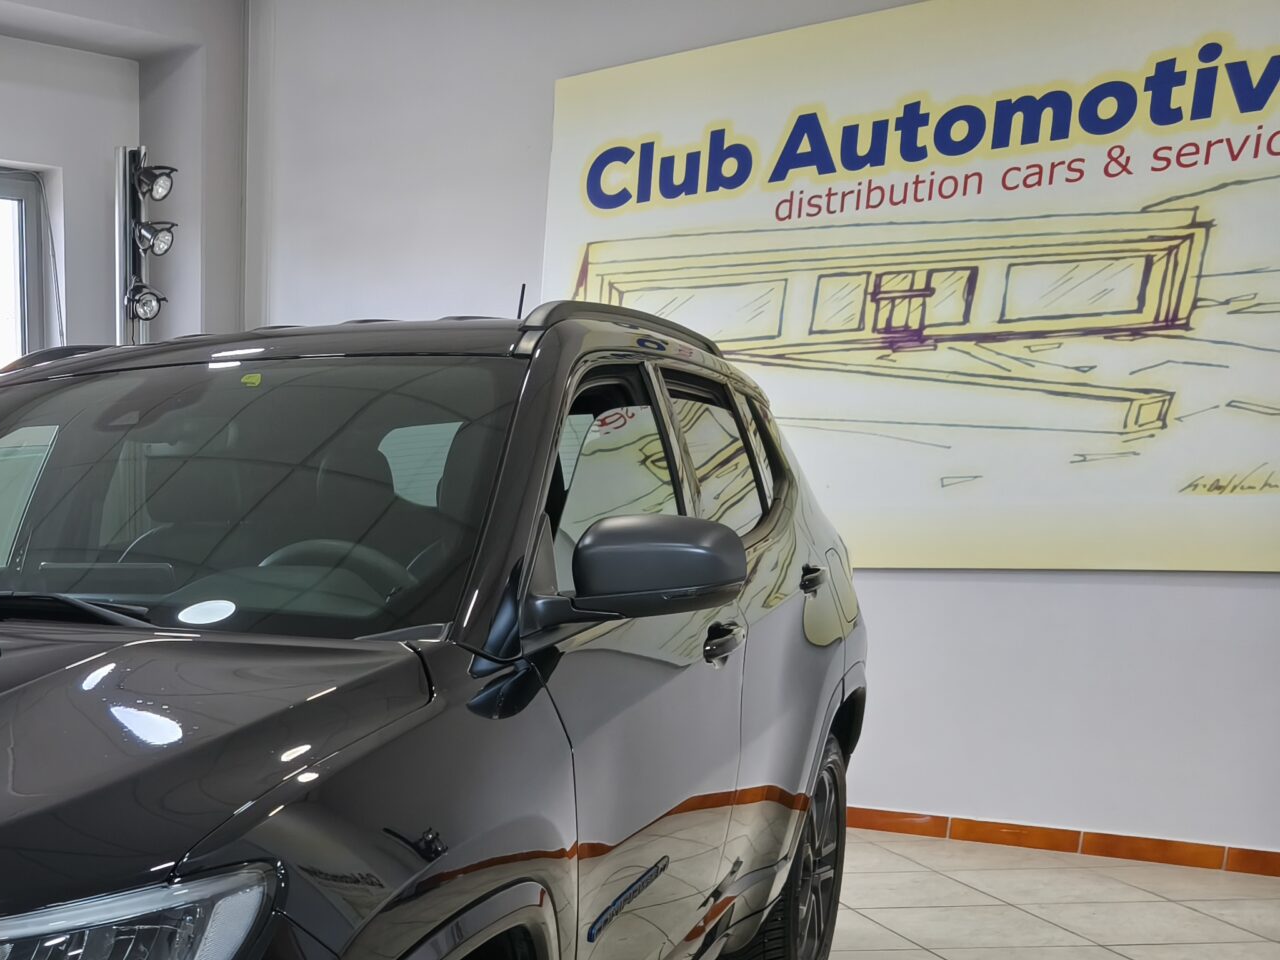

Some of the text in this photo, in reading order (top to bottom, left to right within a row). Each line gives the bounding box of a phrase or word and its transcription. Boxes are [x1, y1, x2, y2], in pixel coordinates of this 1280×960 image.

[585, 42, 1280, 210] Club Automotiv
[774, 172, 984, 222] distribution
[1000, 156, 1086, 191] cars
[1102, 144, 1134, 177] &
